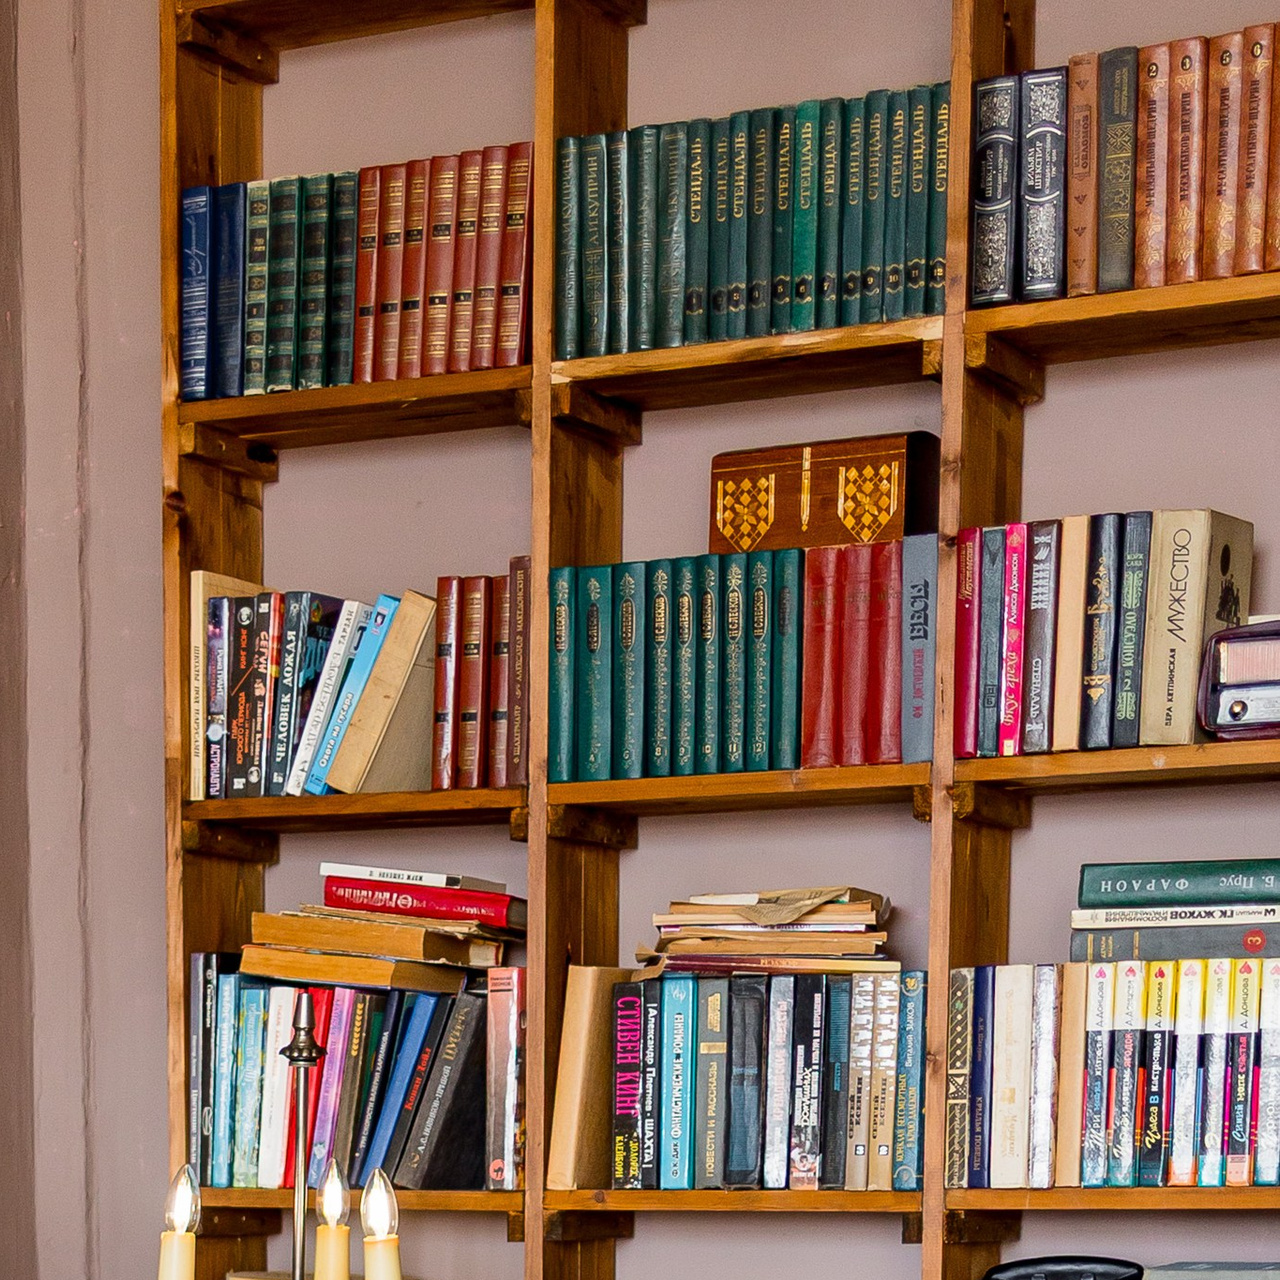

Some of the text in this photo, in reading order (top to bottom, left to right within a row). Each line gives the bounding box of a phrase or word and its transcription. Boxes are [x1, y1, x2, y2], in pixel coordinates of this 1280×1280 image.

[1149, 64, 1158, 77] 2
[1182, 57, 1191, 69] 3
[1223, 52, 1230, 64] 5
[1253, 44, 1261, 56] 6
[690, 137, 702, 223] СТЕНДАЛЬ
[733, 132, 746, 218] СТЕНДАЛЬ
[754, 128, 766, 215] СТЕНДАЛЬ
[778, 122, 790, 210] СТЕНДАЛЬ
[800, 122, 812, 209] СТЕНДАЛЬ
[849, 117, 862, 204] СТЕНДАЛЬ
[869, 112, 881, 200] СТЕНДАЛЬ
[891, 109, 904, 198] СТЕНДАЛЬ
[912, 104, 924, 192] СТЕНДАЛЬ
[935, 103, 949, 191] СТЕНДАЛЬ
[1034, 141, 1043, 190] ШЕКСПИР
[1009, 552, 1019, 624] Алисса Джонсон
[1167, 528, 1192, 642] МУЖЕСТВО
[1122, 611, 1137, 667] КОНСУЭЛО
[1167, 648, 1176, 702] КЕТЛИНСКАЯ
[276, 631, 296, 762] ЧЕЛОВЕК ДОЖДЯ
[1003, 651, 1018, 726] Вкус греха
[320, 692, 354, 768] Охота на гусара
[210, 743, 220, 795] АСТРОНАВТЫ
[1100, 874, 1276, 892] Б. Прус ФАРАОН
[1170, 910, 1216, 920] ЖУКОВ
[906, 1001, 915, 1031] ЗЫКОВ
[1156, 982, 1164, 1016] Донцова
[375, 1031, 390, 1073] ХАРЛАМОВА
[404, 1047, 431, 1110] Конан Дойл
[616, 996, 641, 1116] СТИВЕН КИНГ
[643, 1009, 657, 1164] Александр Плетнев ШАХТА
[671, 1013, 685, 1139] ФАНТАСТИЧЕСКИЕ РОМАНЫ
[1151, 1033, 1161, 1092] кастрюльке
[1237, 1074, 1245, 1101] мопс
[706, 1061, 718, 1177] ПОВЕСТИ И РАССКАЗЫ
[973, 1096, 983, 1171] КРЫЛЬЯ ПОБЕДЫ
[1232, 1099, 1243, 1143] Синий
